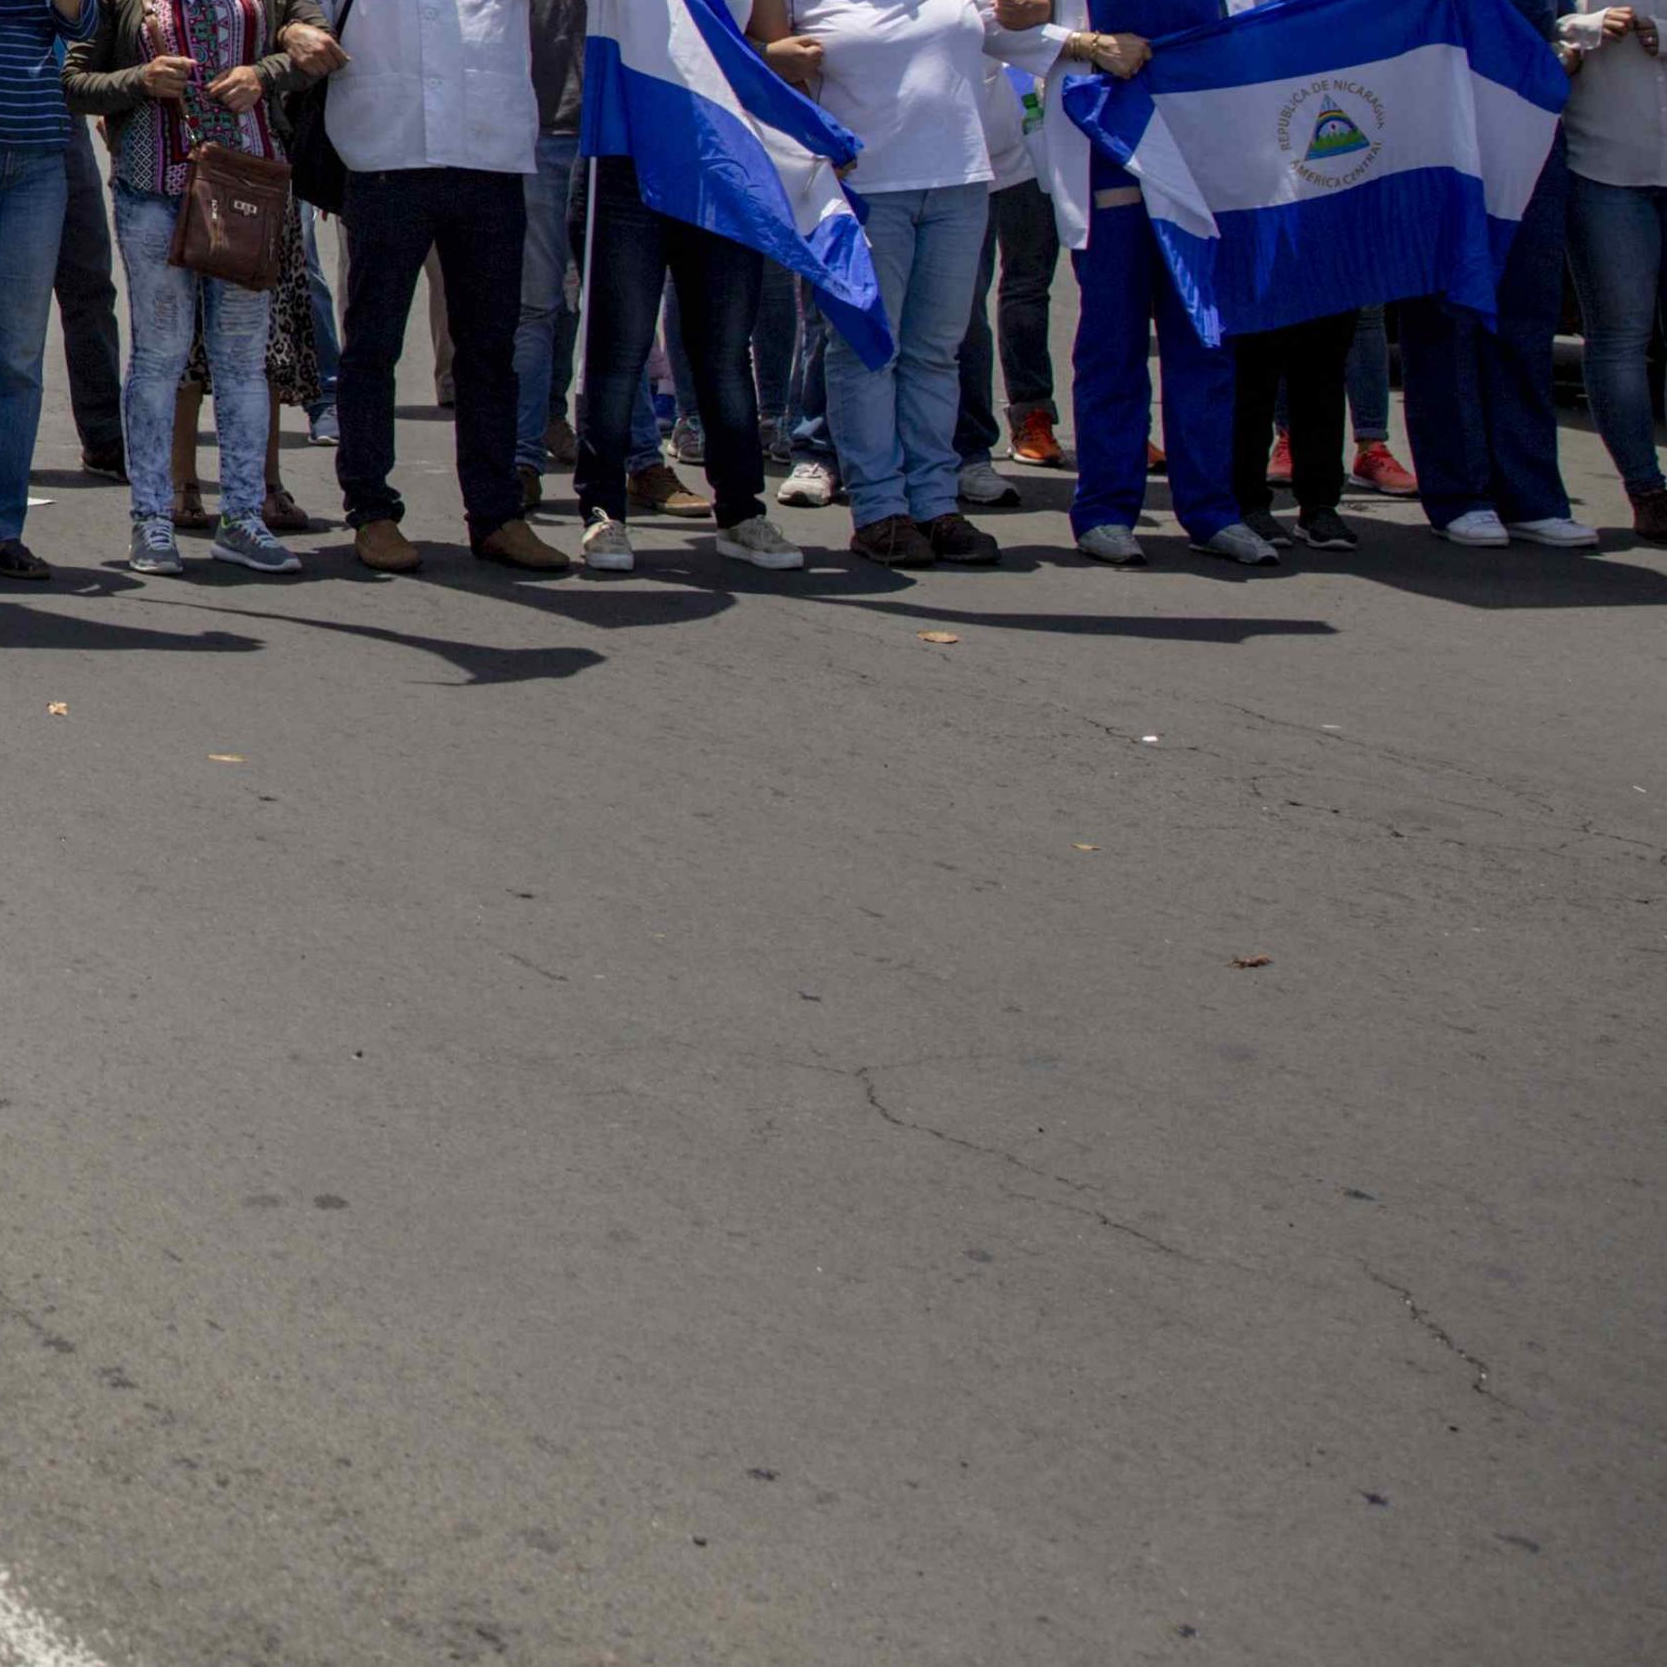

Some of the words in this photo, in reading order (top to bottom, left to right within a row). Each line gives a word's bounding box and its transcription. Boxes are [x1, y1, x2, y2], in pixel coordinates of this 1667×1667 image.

[1277, 87, 1310, 152] REPUBLICA
[1311, 79, 1330, 95] DE
[1333, 79, 1385, 130] NICARAGUA
